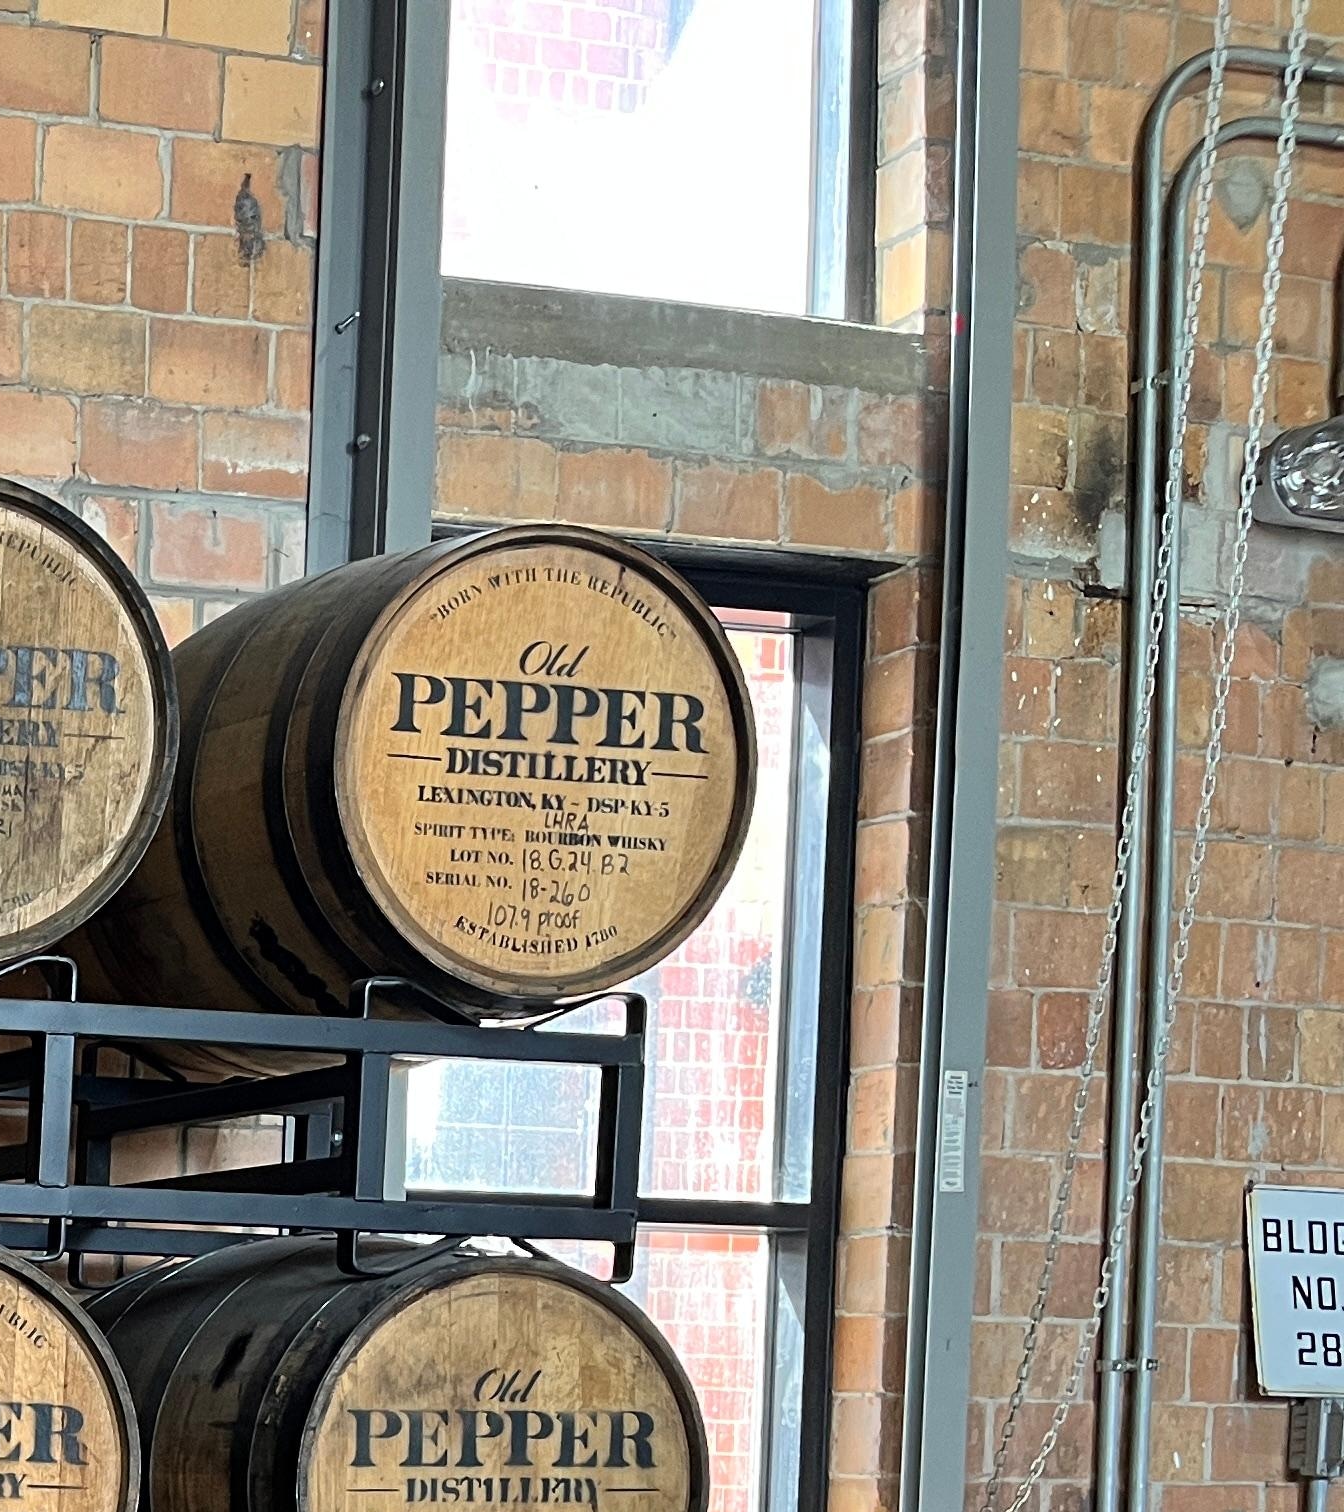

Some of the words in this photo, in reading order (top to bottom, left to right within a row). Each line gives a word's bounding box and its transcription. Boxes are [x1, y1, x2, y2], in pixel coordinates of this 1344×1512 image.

[487, 568, 537, 591] WITH
[543, 568, 583, 587] THE
[518, 640, 591, 678] Old
[390, 671, 709, 754] PEPPER
[445, 747, 652, 786] DISTILLERY
[417, 785, 536, 809] LEXINGTON,
[540, 793, 567, 811] KY
[414, 822, 466, 839] SPIRIT
[470, 826, 516, 842] TYPE:
[524, 830, 602, 847] BOURBON
[607, 835, 670, 851] WHISKY
[450, 849, 483, 863] LOT
[486, 851, 515, 866] NO.
[425, 871, 481, 887] SERIAL
[485, 875, 512, 889] NO.
[522, 878, 591, 906] 18-260
[454, 915, 579, 954] ESTABLISHED
[584, 924, 618, 950] 1780
[1297, 1332, 1342, 1367] 28
[472, 1367, 543, 1404] Old
[346, 1407, 657, 1469] PEPPER
[405, 1476, 600, 1502] DISTILLERY
